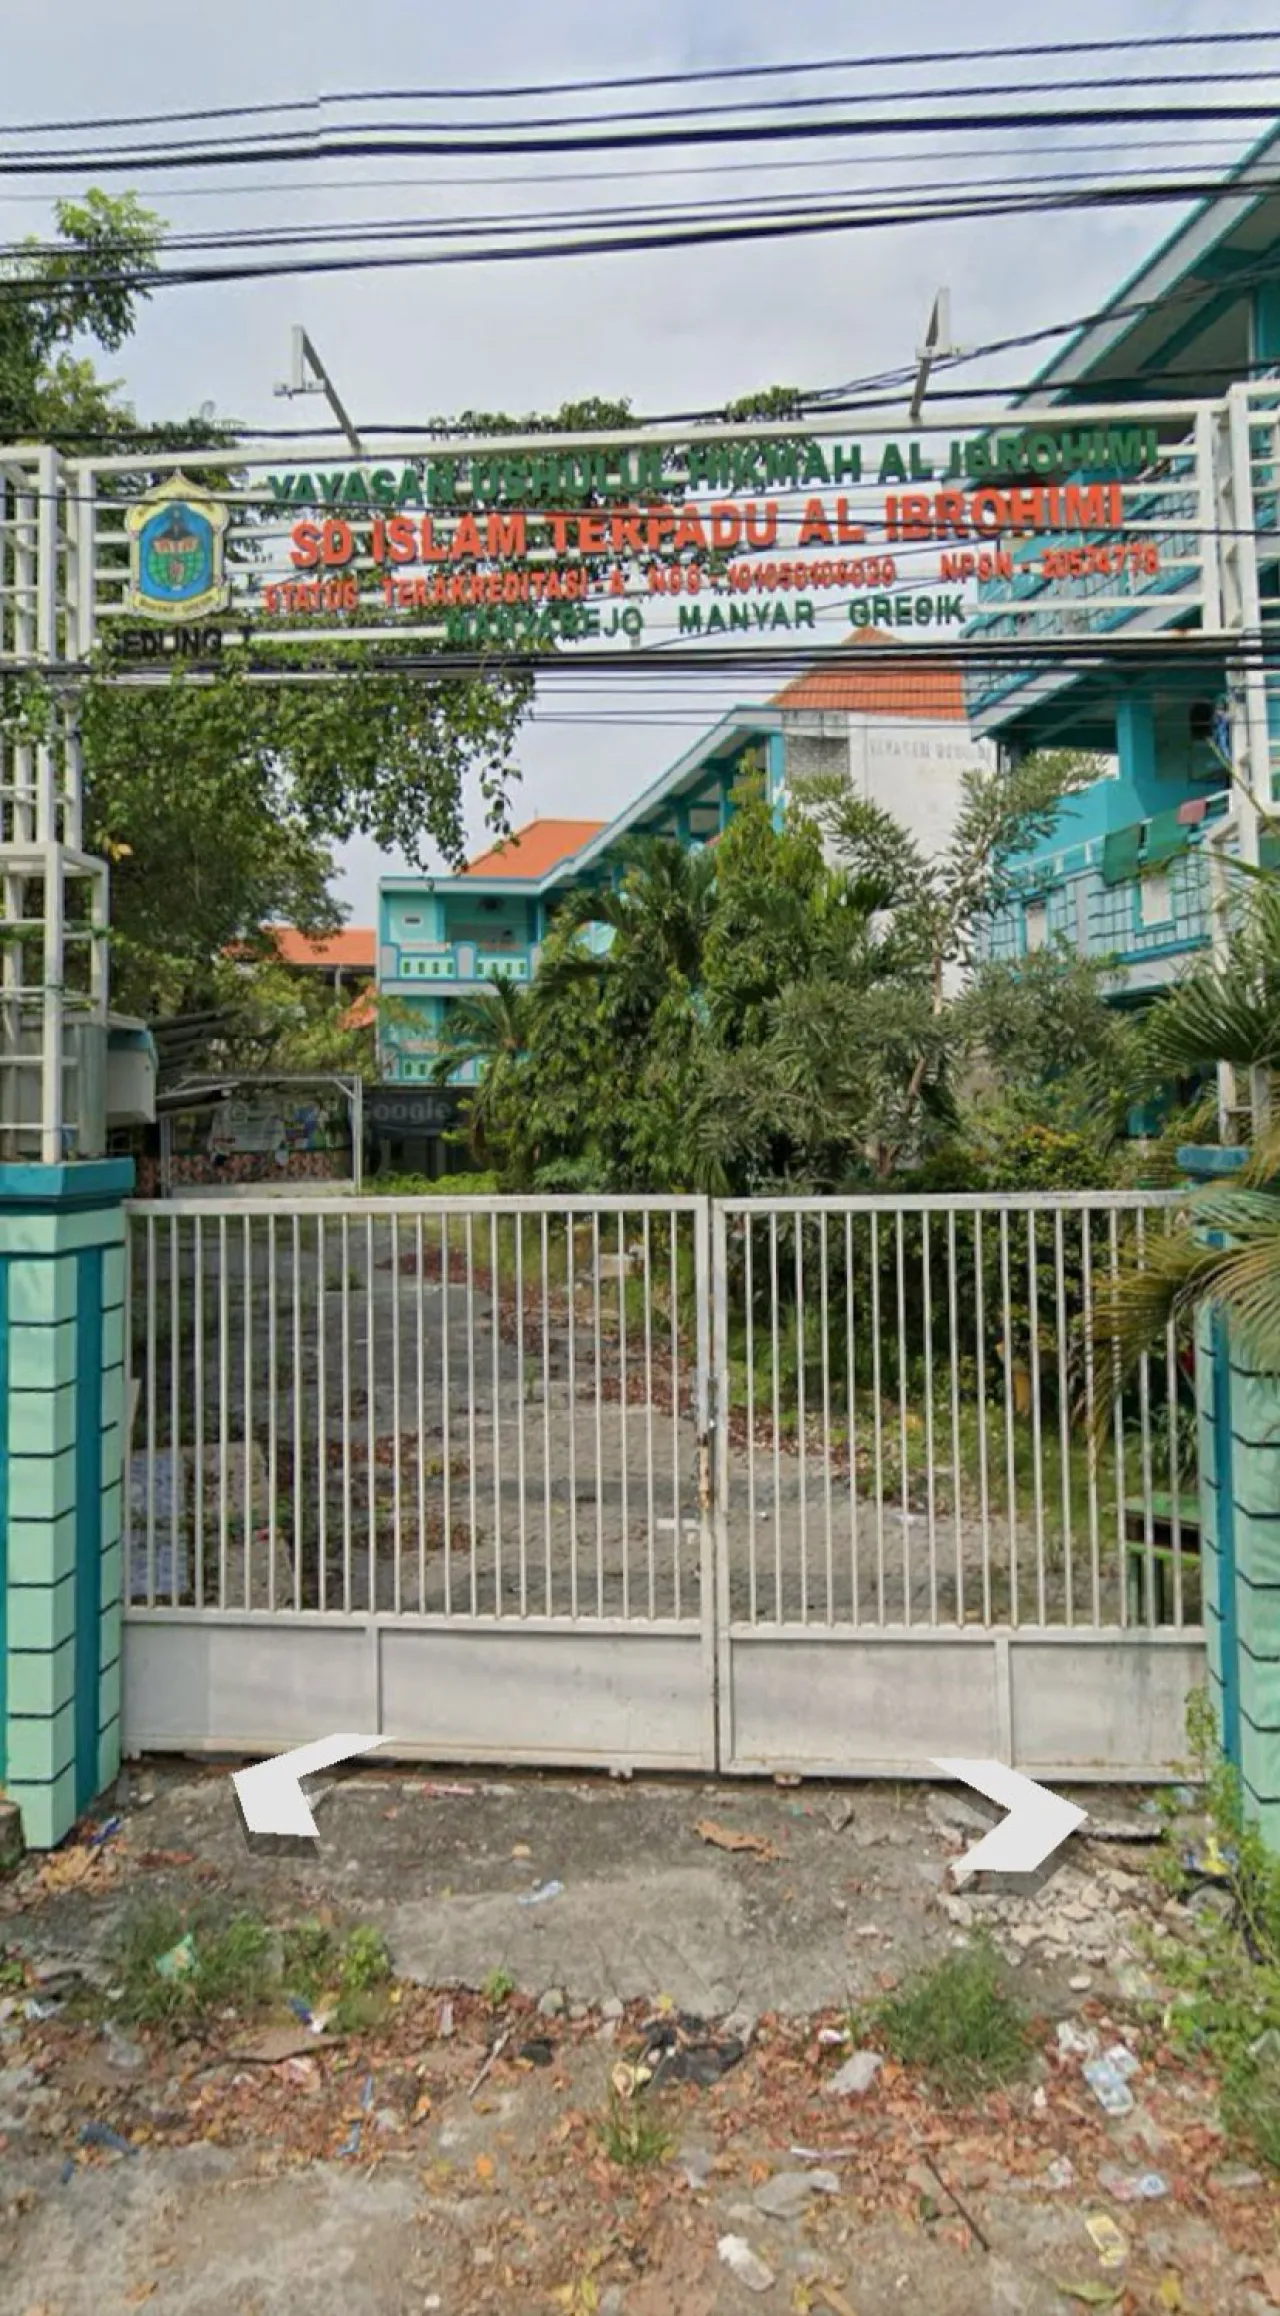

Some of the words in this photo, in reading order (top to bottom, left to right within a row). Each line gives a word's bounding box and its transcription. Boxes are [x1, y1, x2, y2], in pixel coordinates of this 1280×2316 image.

[267, 466, 455, 502] YAYASAN
[472, 450, 681, 499] USHULUL
[687, 444, 862, 491] HIKMAH
[878, 442, 933, 482] AL
[948, 429, 1160, 478] IBROHIMI
[289, 518, 353, 569] SD
[372, 510, 527, 564] ISLAM
[544, 501, 779, 555] TERPADU
[799, 498, 866, 545] AL
[885, 481, 1124, 543] IBROHIMI
[263, 577, 358, 613] STATUS
[381, 566, 588, 606] TERAKREDITASI
[940, 551, 1014, 583] NPSN
[107, 627, 223, 657] EDUNG
[444, 602, 644, 642] MANYAREJO
[678, 599, 816, 635] MANYAR
[848, 594, 967, 630] GRESIK
